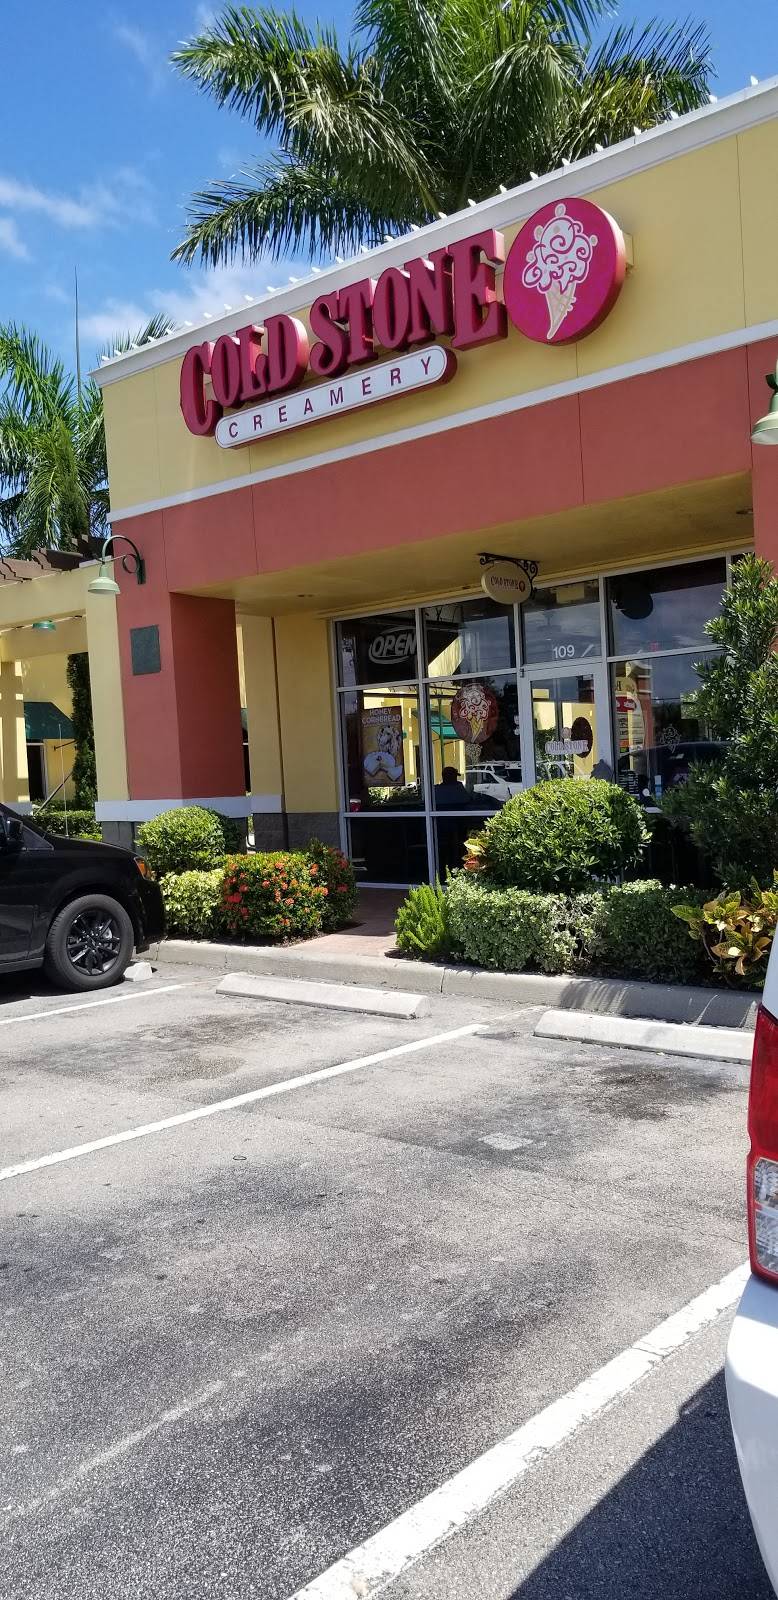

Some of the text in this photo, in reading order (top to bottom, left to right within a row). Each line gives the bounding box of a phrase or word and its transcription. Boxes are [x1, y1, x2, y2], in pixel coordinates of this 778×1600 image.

[180, 229, 507, 437] COLD STONE
[229, 355, 433, 438] CREAMERY
[372, 632, 418, 657] OPEN
[553, 645, 575, 658] 109
[362, 714, 401, 725] CORNBREAD
[369, 707, 392, 716] HONEY
